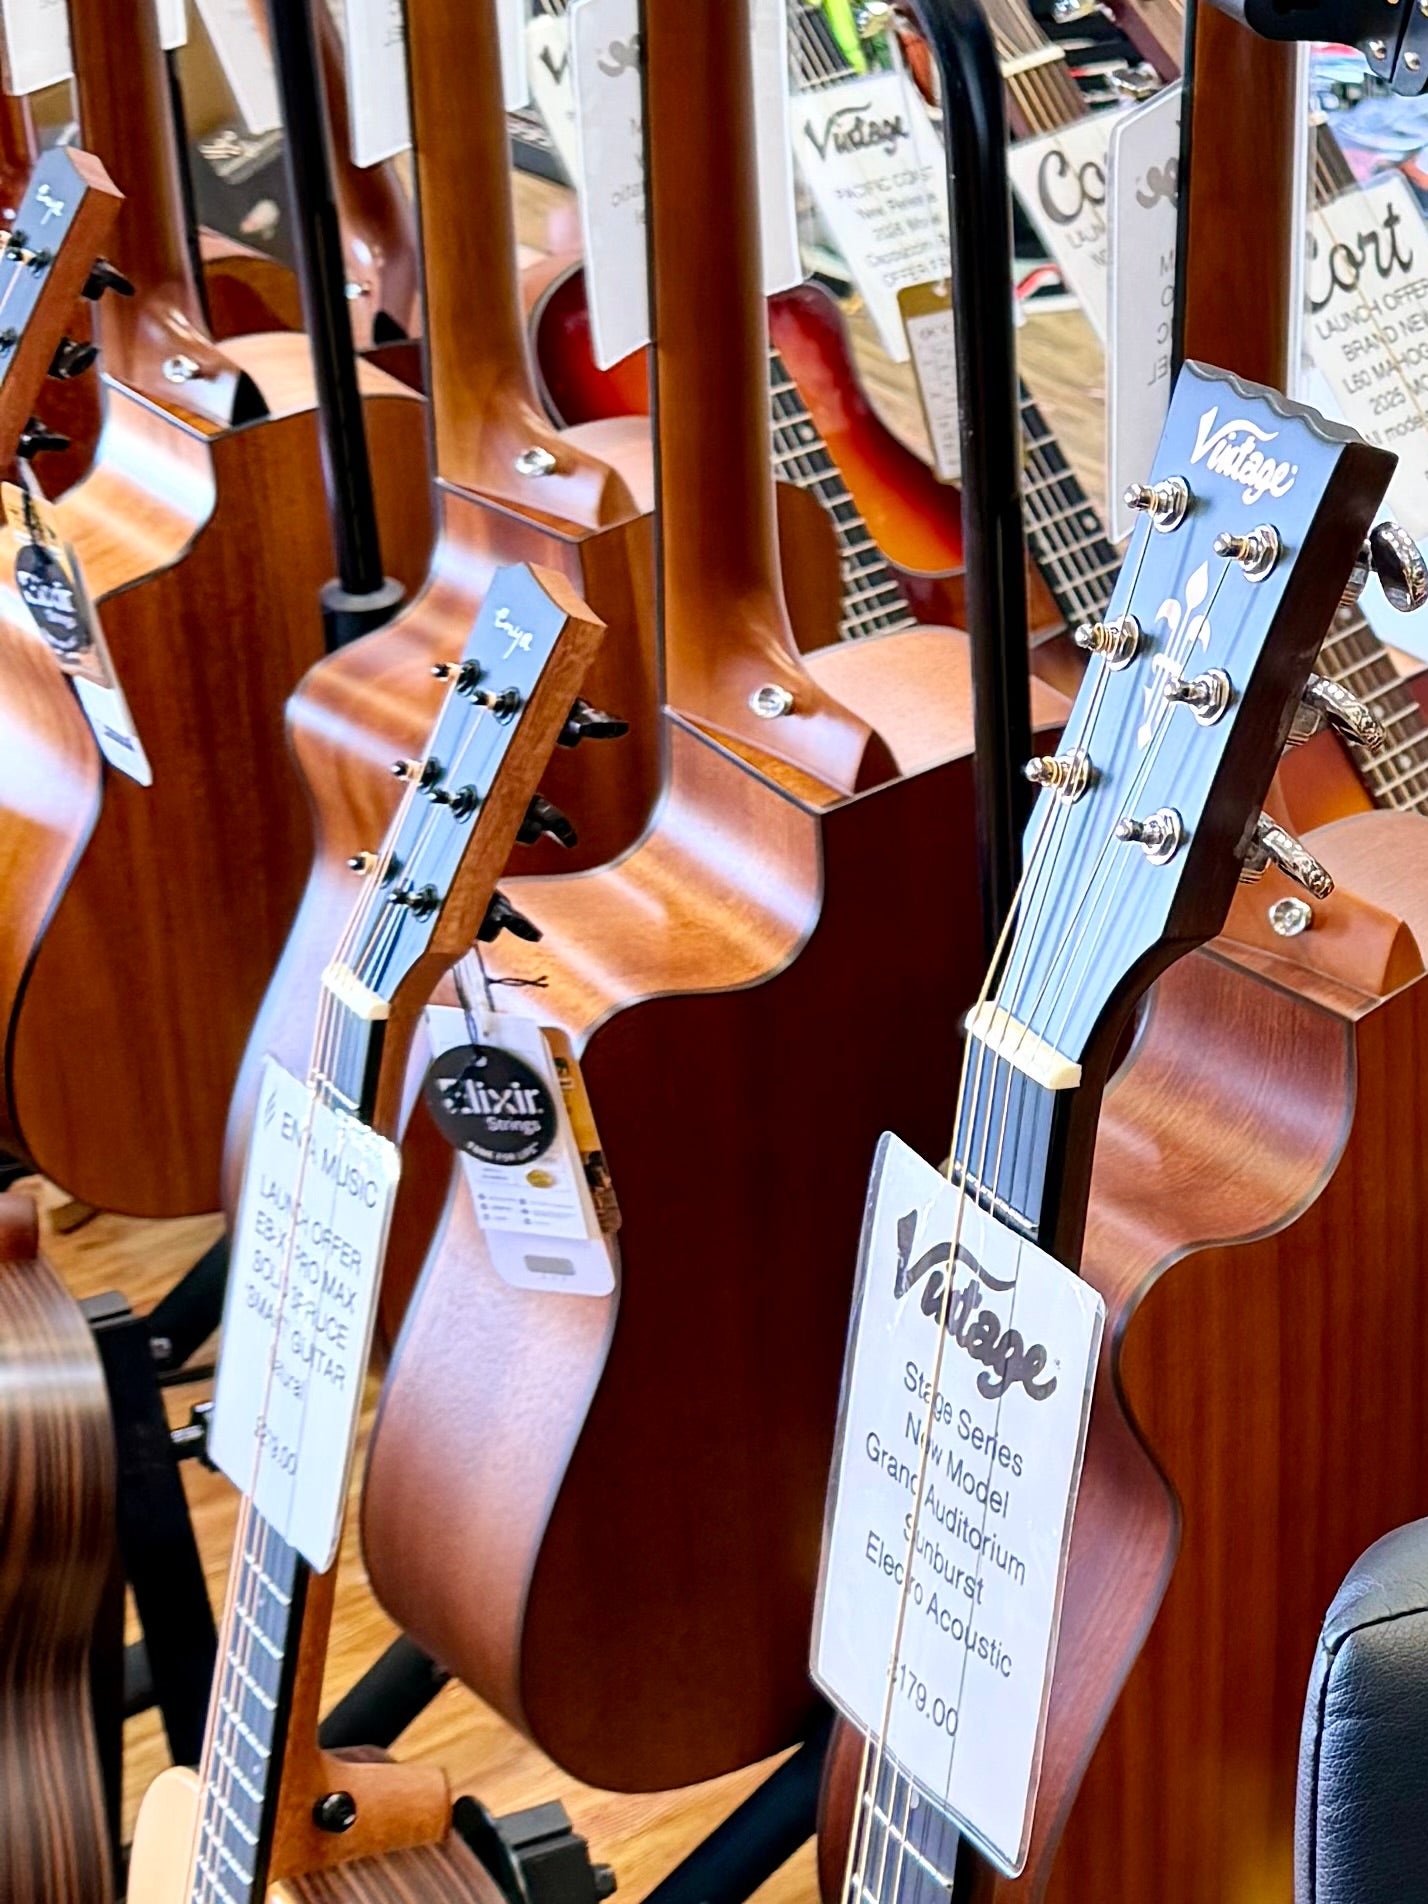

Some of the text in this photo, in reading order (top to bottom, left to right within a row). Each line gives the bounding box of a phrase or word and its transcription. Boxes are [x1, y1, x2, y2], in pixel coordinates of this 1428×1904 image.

[803, 102, 911, 158] Vintage
[1038, 150, 1106, 225] Co
[1315, 299, 1381, 341] LAUNCH
[1340, 325, 1398, 363] BRAND
[1190, 405, 1299, 506] Vintage
[485, 1116, 542, 1136] Strings
[321, 1147, 379, 1210] MUSIC
[311, 1221, 363, 1278] OFFER
[321, 1269, 360, 1316] MAX
[893, 1206, 1062, 1402] Vintage
[290, 1329, 347, 1391] GUITAR
[901, 1359, 1025, 1481] Stage Series
[903, 1411, 1011, 1520] New Model
[901, 1514, 985, 1609] Sunburst
[922, 1483, 1028, 1588] Auditorium
[925, 1589, 1014, 1680] Acoustic
